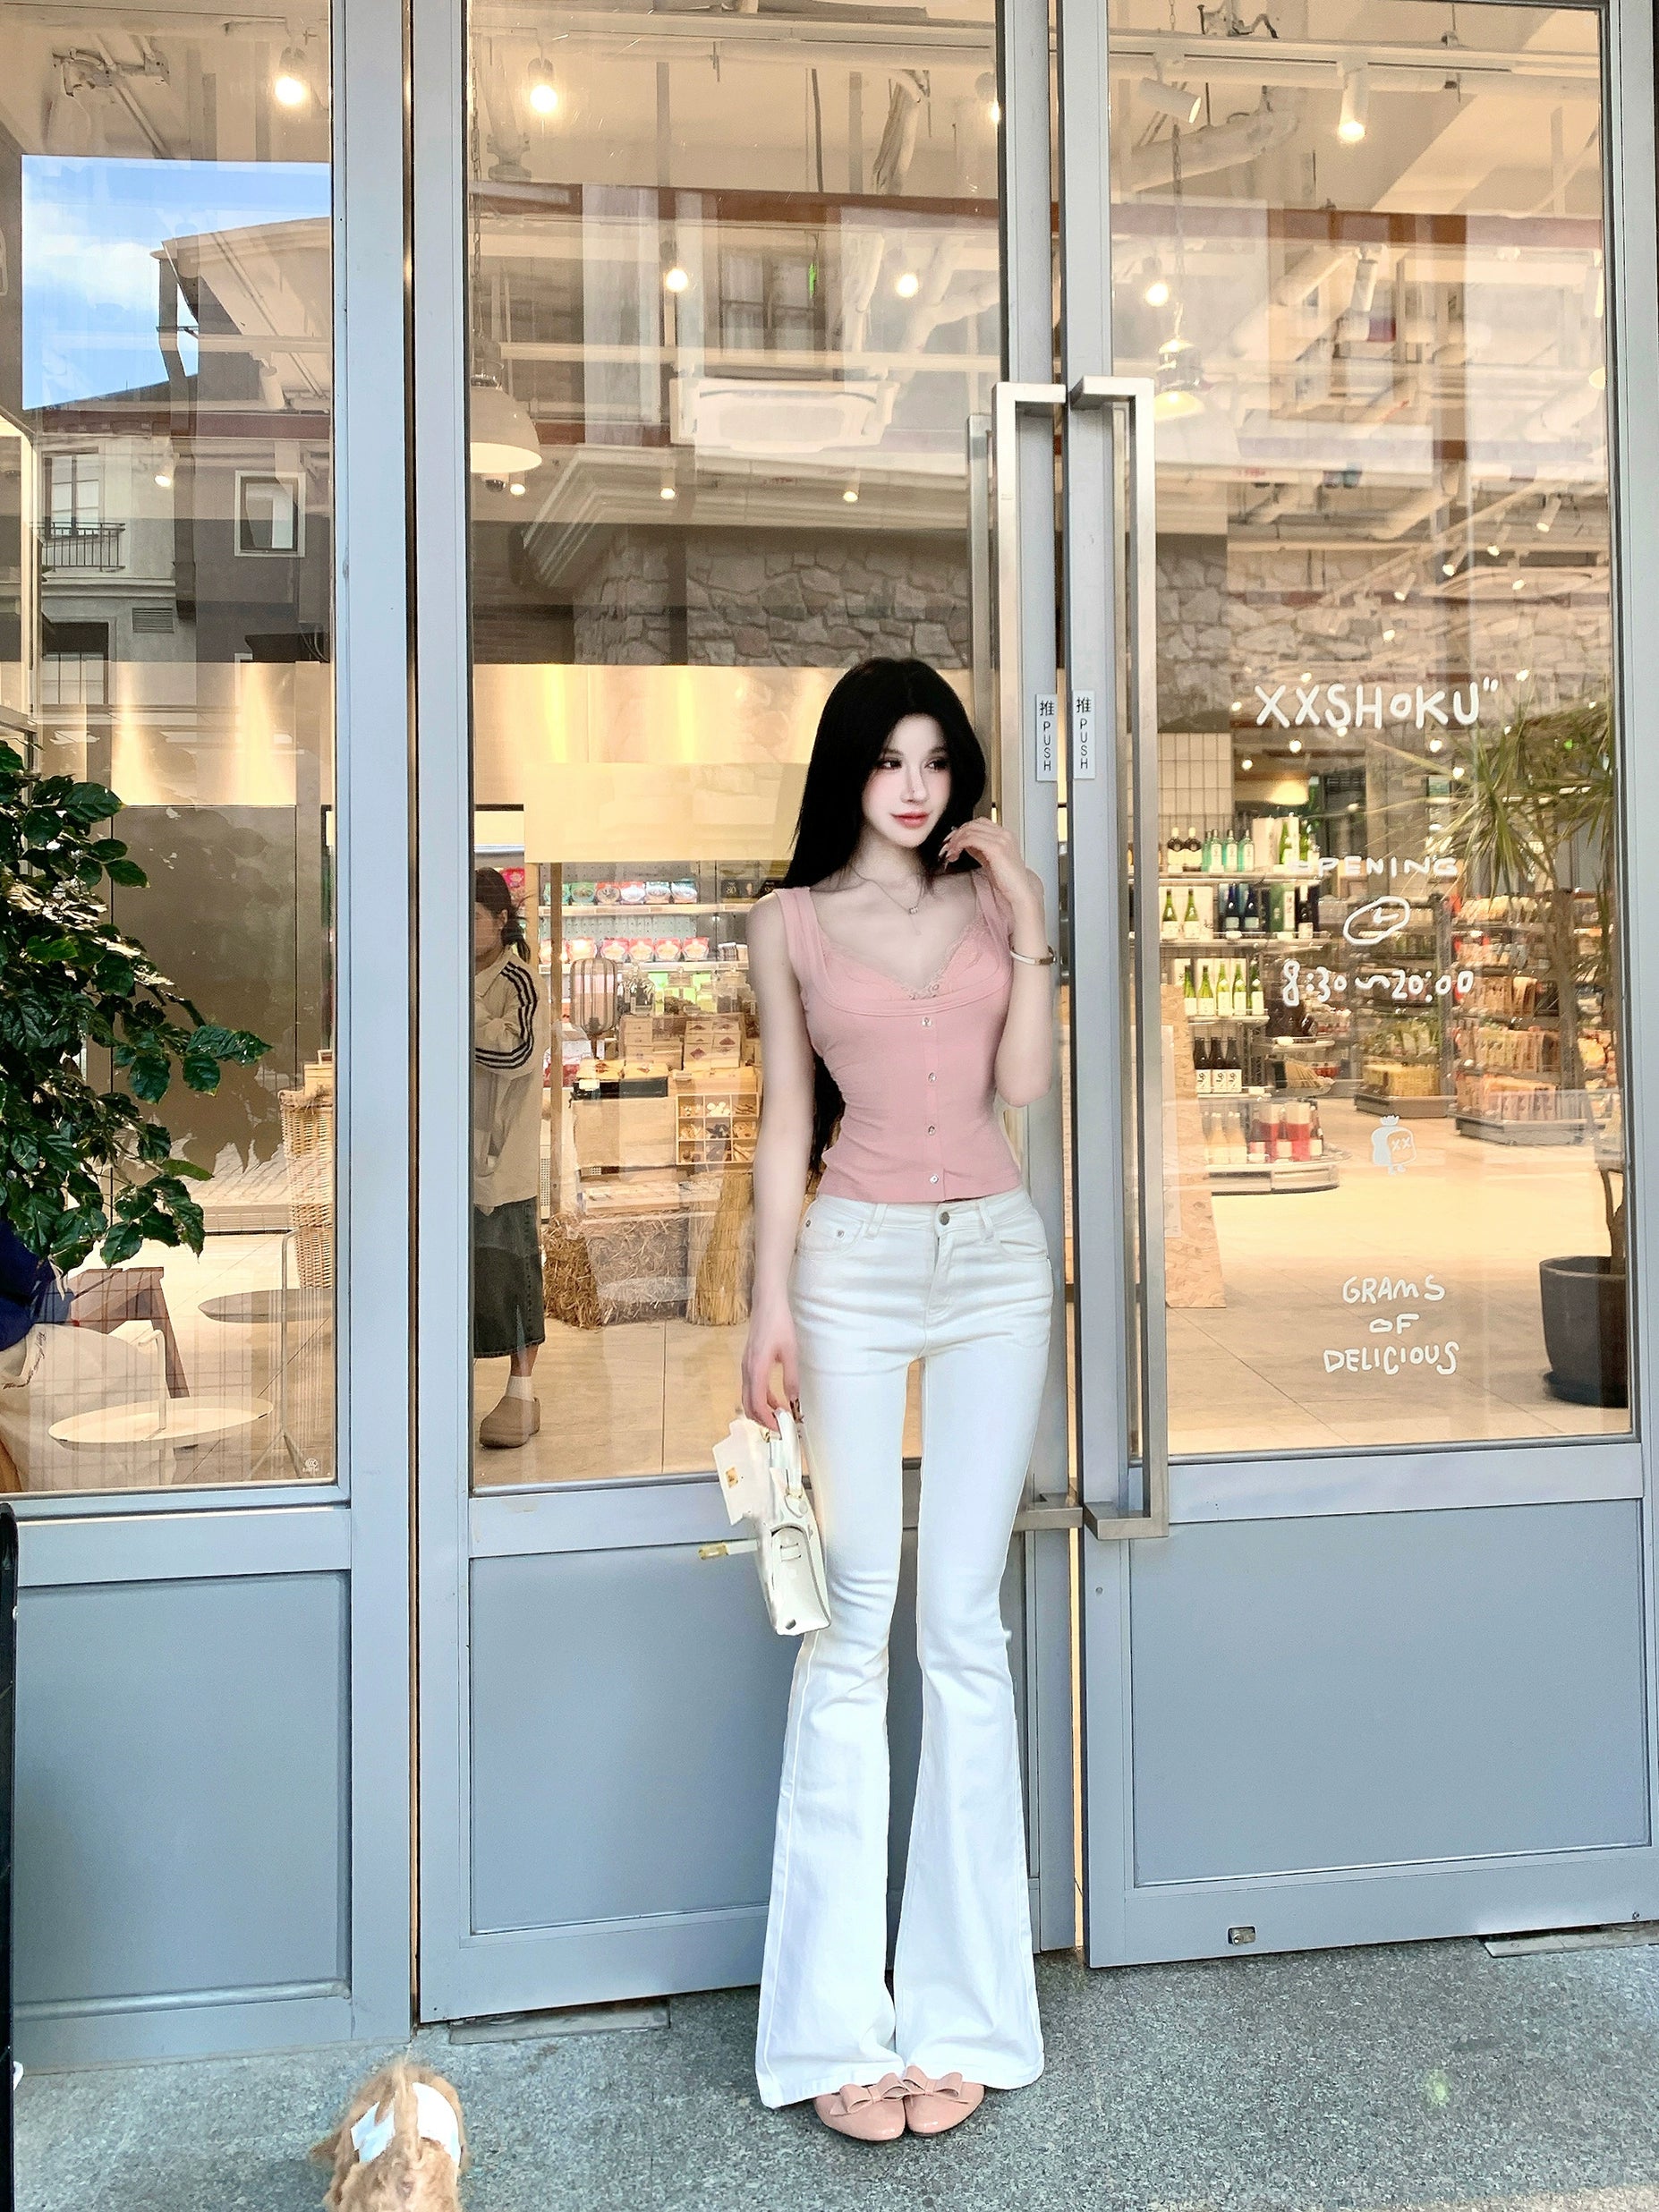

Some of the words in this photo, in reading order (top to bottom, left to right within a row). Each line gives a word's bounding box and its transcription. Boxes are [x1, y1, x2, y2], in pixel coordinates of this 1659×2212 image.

[1039, 700, 1054, 717] 推
[1076, 696, 1092, 714] 推
[1042, 720, 1051, 771] PUSH
[1079, 718, 1088, 770] PUSH
[1342, 1273, 1446, 1304] GRAMS
[1369, 1313, 1420, 1335] OF
[1323, 1340, 1460, 1375] DELICIOUS
